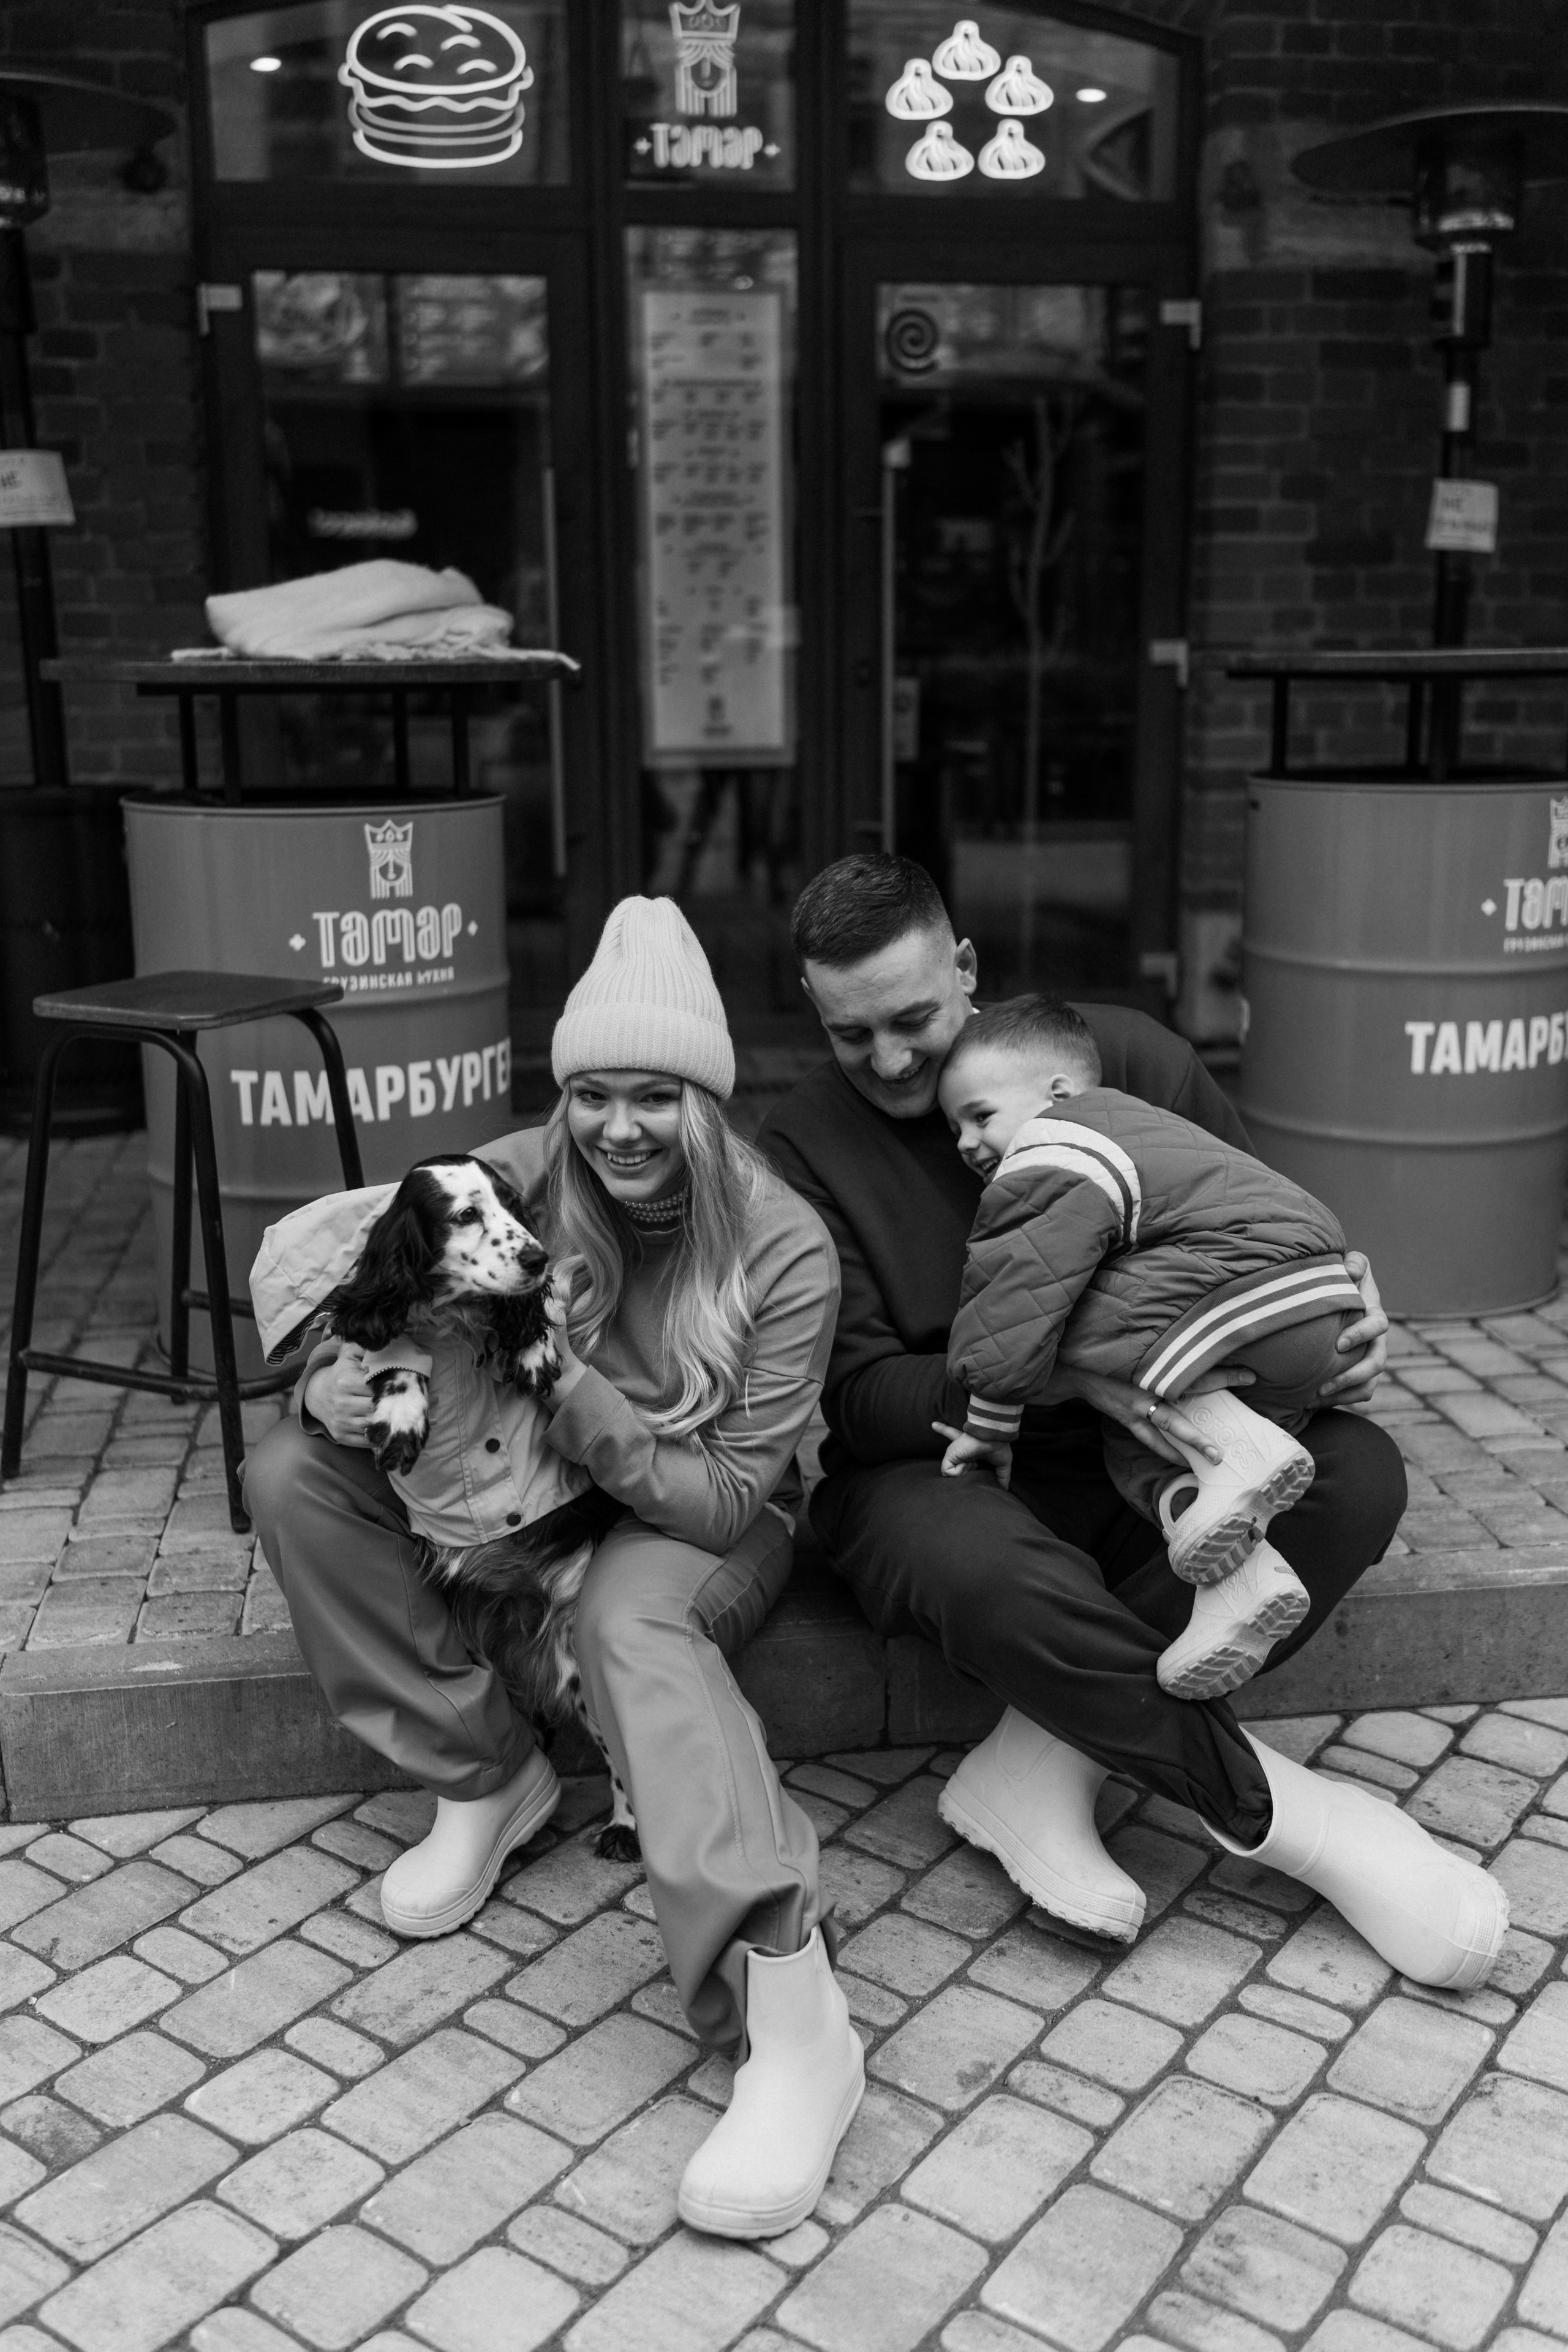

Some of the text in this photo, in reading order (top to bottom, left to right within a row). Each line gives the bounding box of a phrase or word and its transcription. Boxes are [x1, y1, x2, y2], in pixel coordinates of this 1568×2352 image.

[1405, 1009, 1568, 1074] ТАМАРБ
[230, 1037, 511, 1126] ТАМАРБУРГЕ
[1191, 1408, 1257, 1470] crocs
